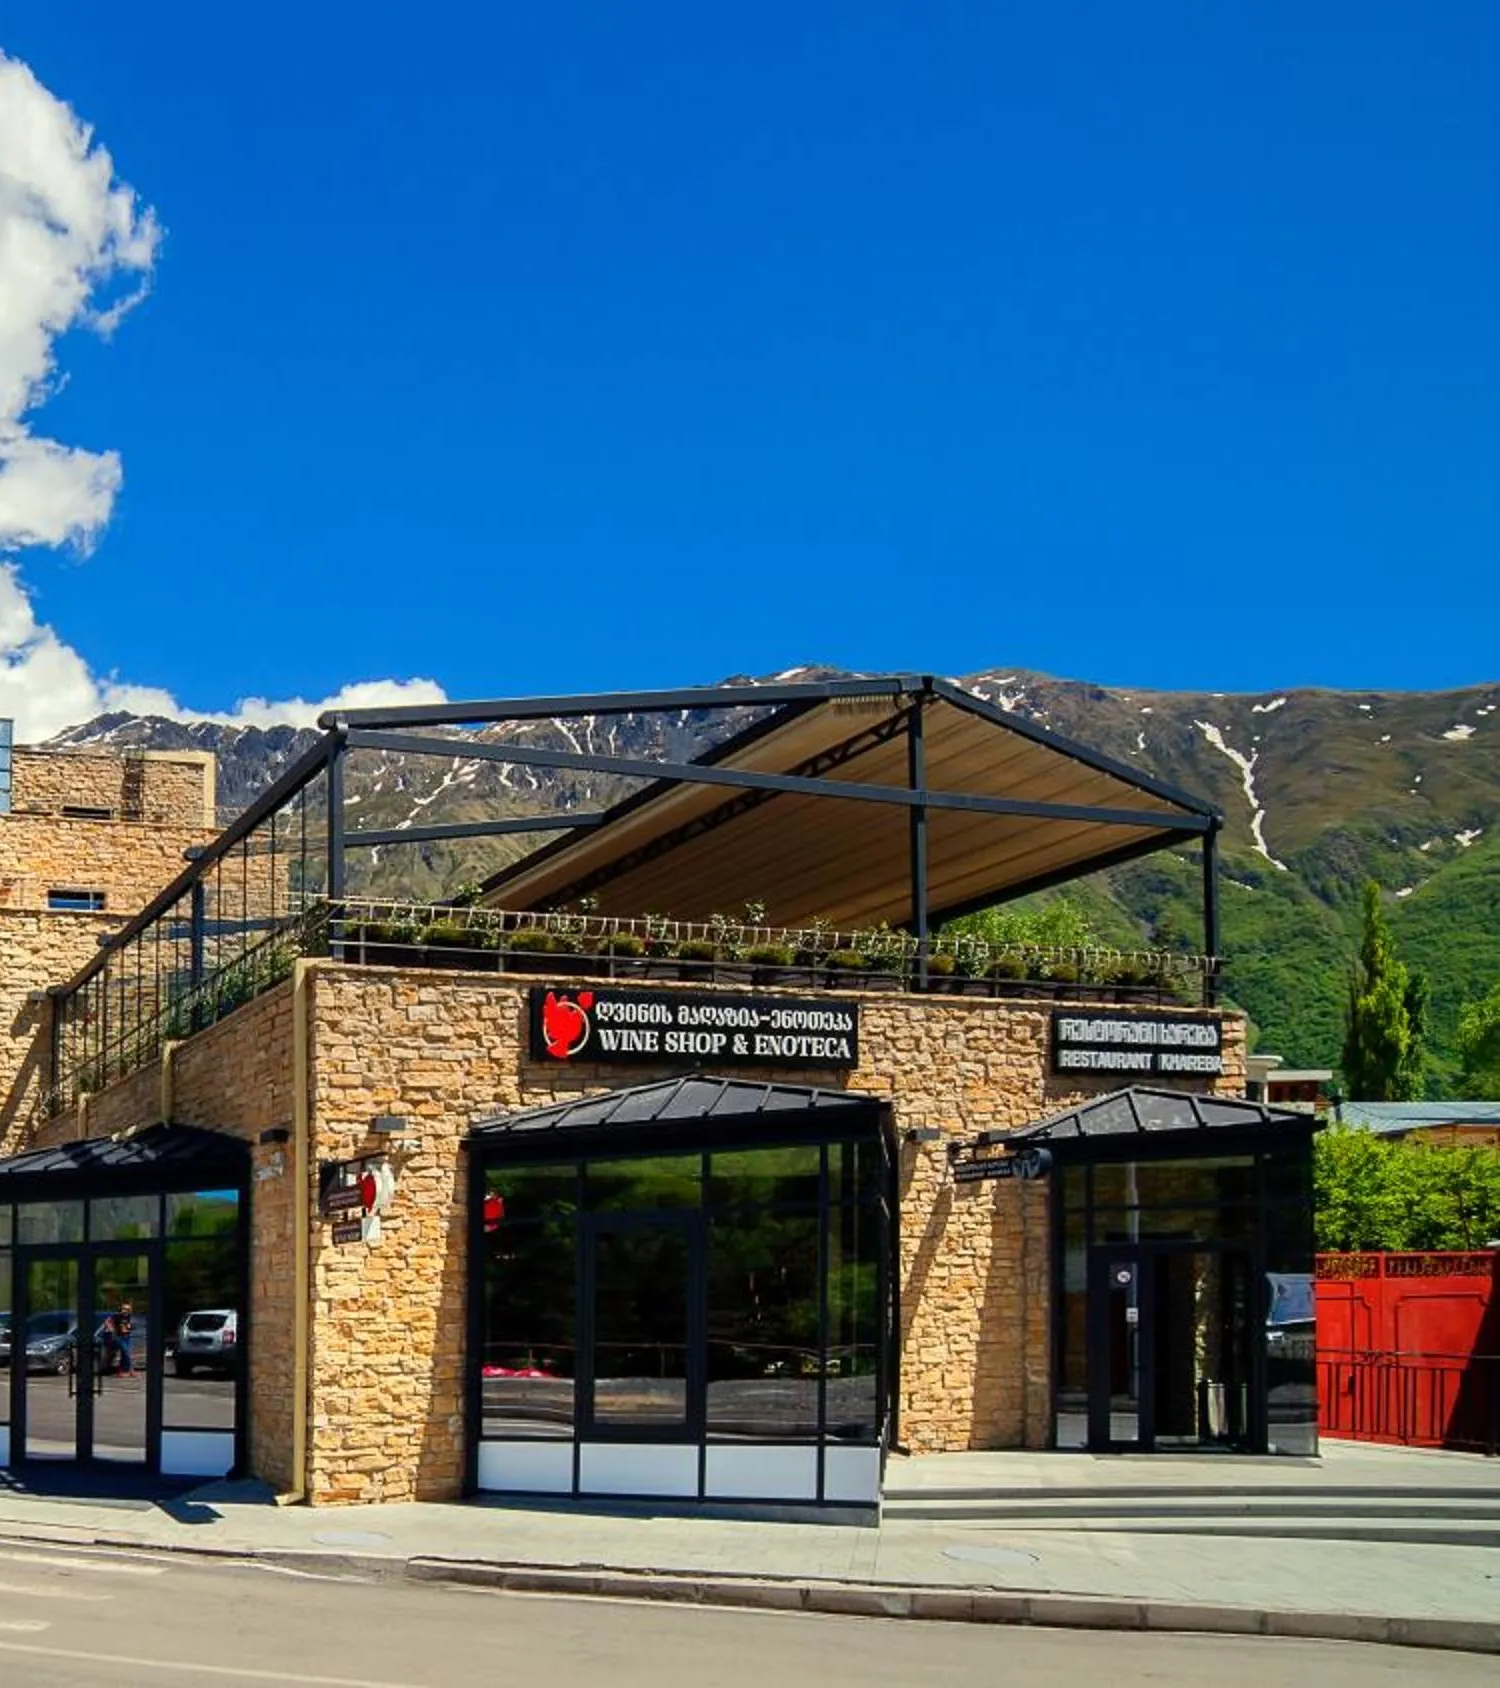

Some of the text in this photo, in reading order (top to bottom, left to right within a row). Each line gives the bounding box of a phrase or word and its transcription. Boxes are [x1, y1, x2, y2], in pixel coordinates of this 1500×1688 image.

[595, 1001, 854, 1031] ღვინის მაღაზია-ენოთეკა
[597, 1029, 852, 1059] WINE SHOP & ENOTECA
[1059, 1049, 1152, 1070] RESTAURANT
